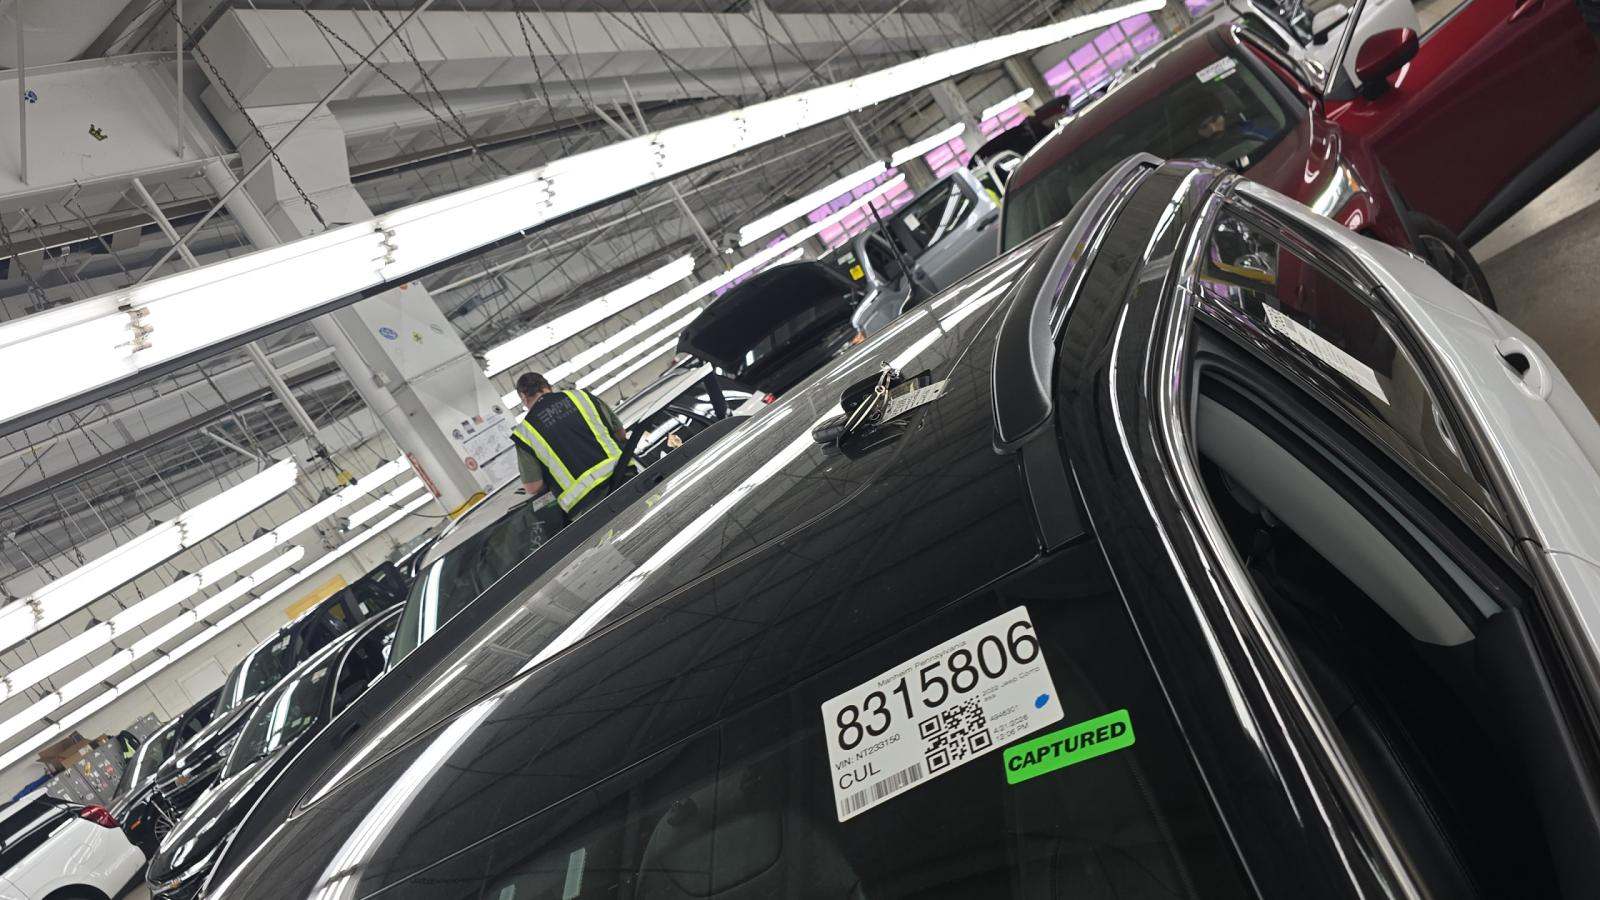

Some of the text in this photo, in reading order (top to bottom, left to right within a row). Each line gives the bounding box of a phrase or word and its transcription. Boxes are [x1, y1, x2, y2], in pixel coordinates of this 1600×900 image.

[835, 620, 1040, 751] 8315806
[878, 640, 967, 688] Manheim Pennsylvania
[835, 733, 900, 770] VIN: NT233150
[1007, 721, 1127, 773] CAPTURED
[839, 762, 881, 790] CUL
